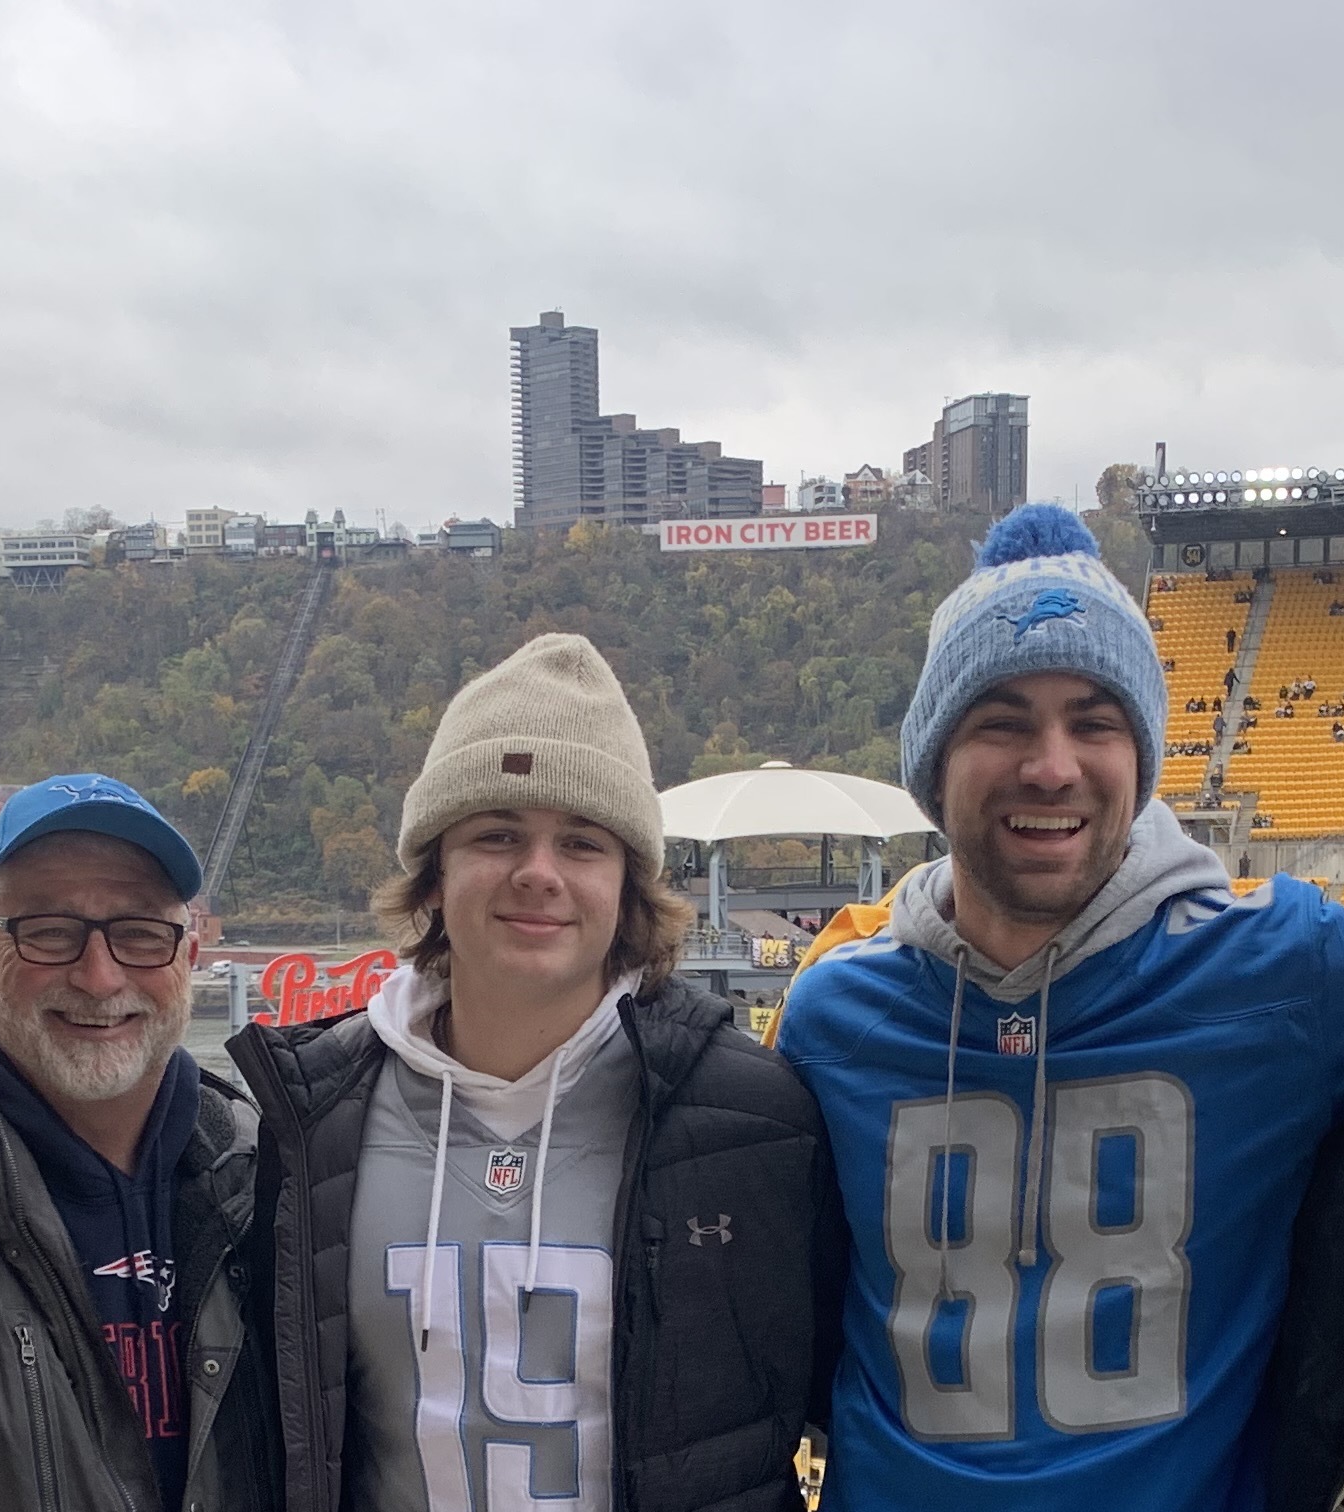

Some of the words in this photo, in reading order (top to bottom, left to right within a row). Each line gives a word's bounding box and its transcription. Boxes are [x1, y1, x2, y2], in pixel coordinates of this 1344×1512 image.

[666, 524, 733, 545] IRON
[739, 522, 797, 544] CITY
[804, 519, 871, 541] BEER
[761, 939, 791, 953] WE
[1003, 1035, 1030, 1053] NFL
[491, 1166, 520, 1187] NFL
[884, 1070, 1195, 1442] 88
